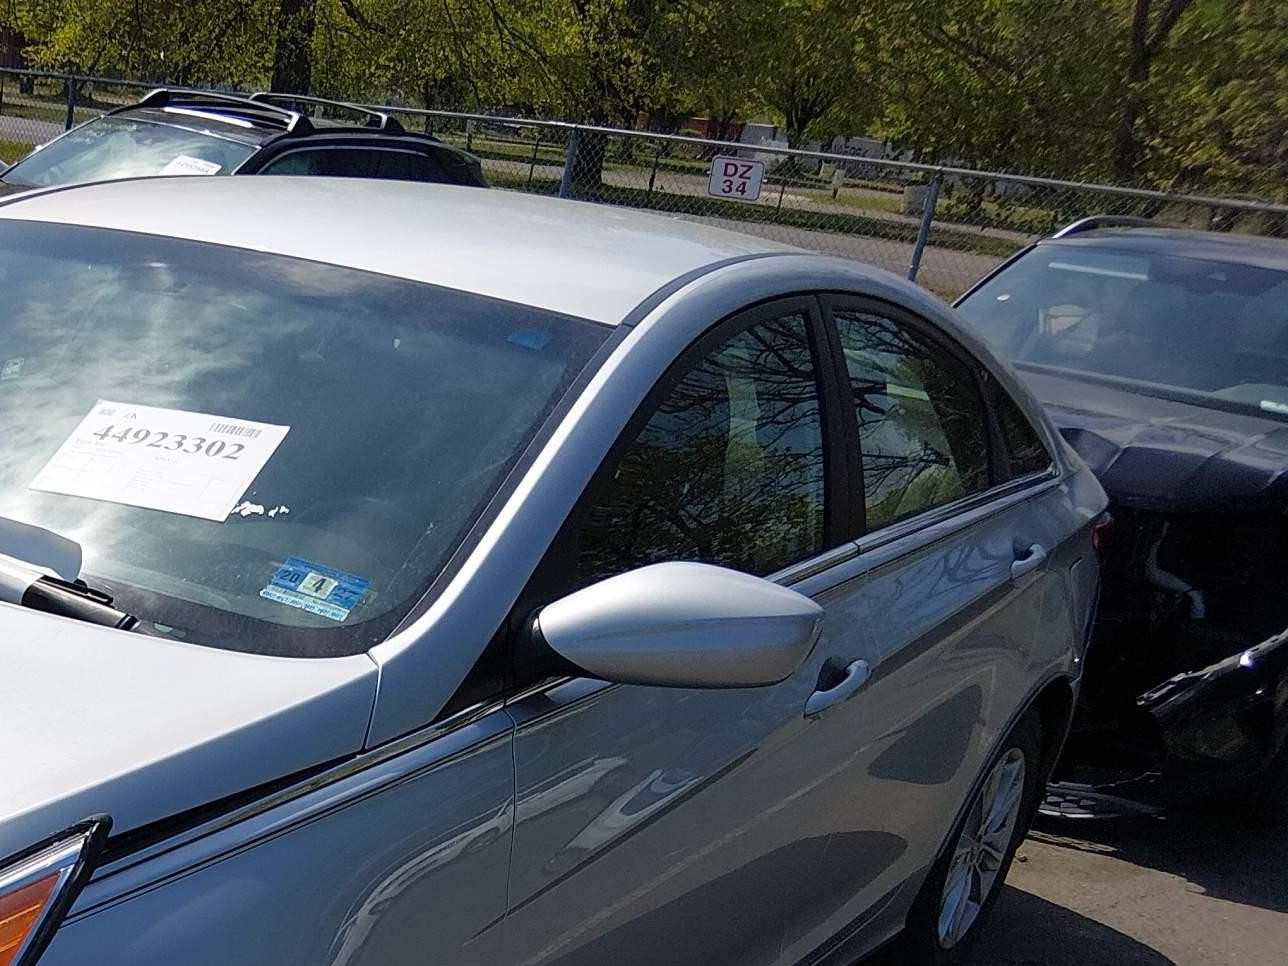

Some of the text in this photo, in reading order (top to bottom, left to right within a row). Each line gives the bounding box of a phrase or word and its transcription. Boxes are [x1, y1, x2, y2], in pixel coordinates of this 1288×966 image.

[723, 162, 754, 180] DZ
[721, 179, 748, 196] 34
[92, 423, 246, 461] 44923302
[279, 568, 302, 583] 20
[312, 577, 328, 593] 4
